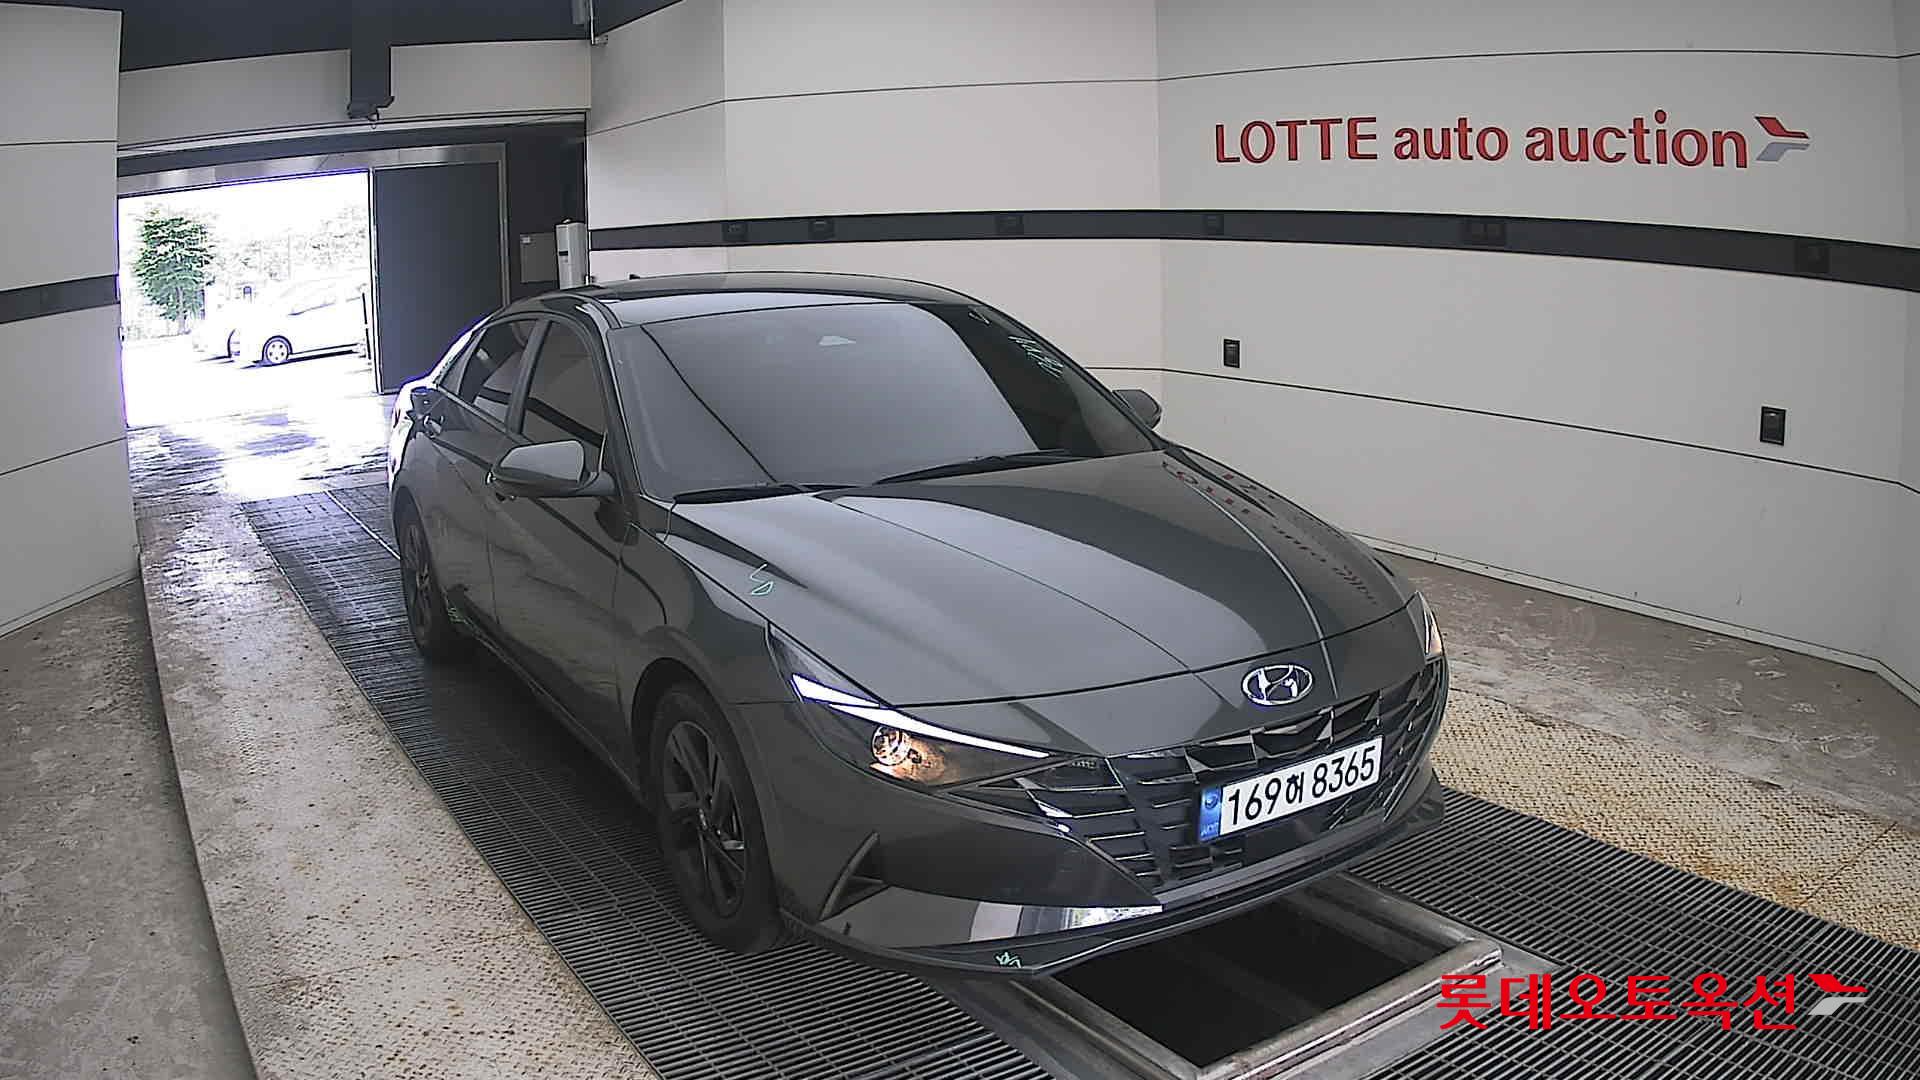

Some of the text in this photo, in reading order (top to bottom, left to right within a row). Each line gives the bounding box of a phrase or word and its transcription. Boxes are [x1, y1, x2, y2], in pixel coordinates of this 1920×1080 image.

[1215, 109, 1748, 168] LOTTE auto auction
[1312, 745, 1376, 799] 8365
